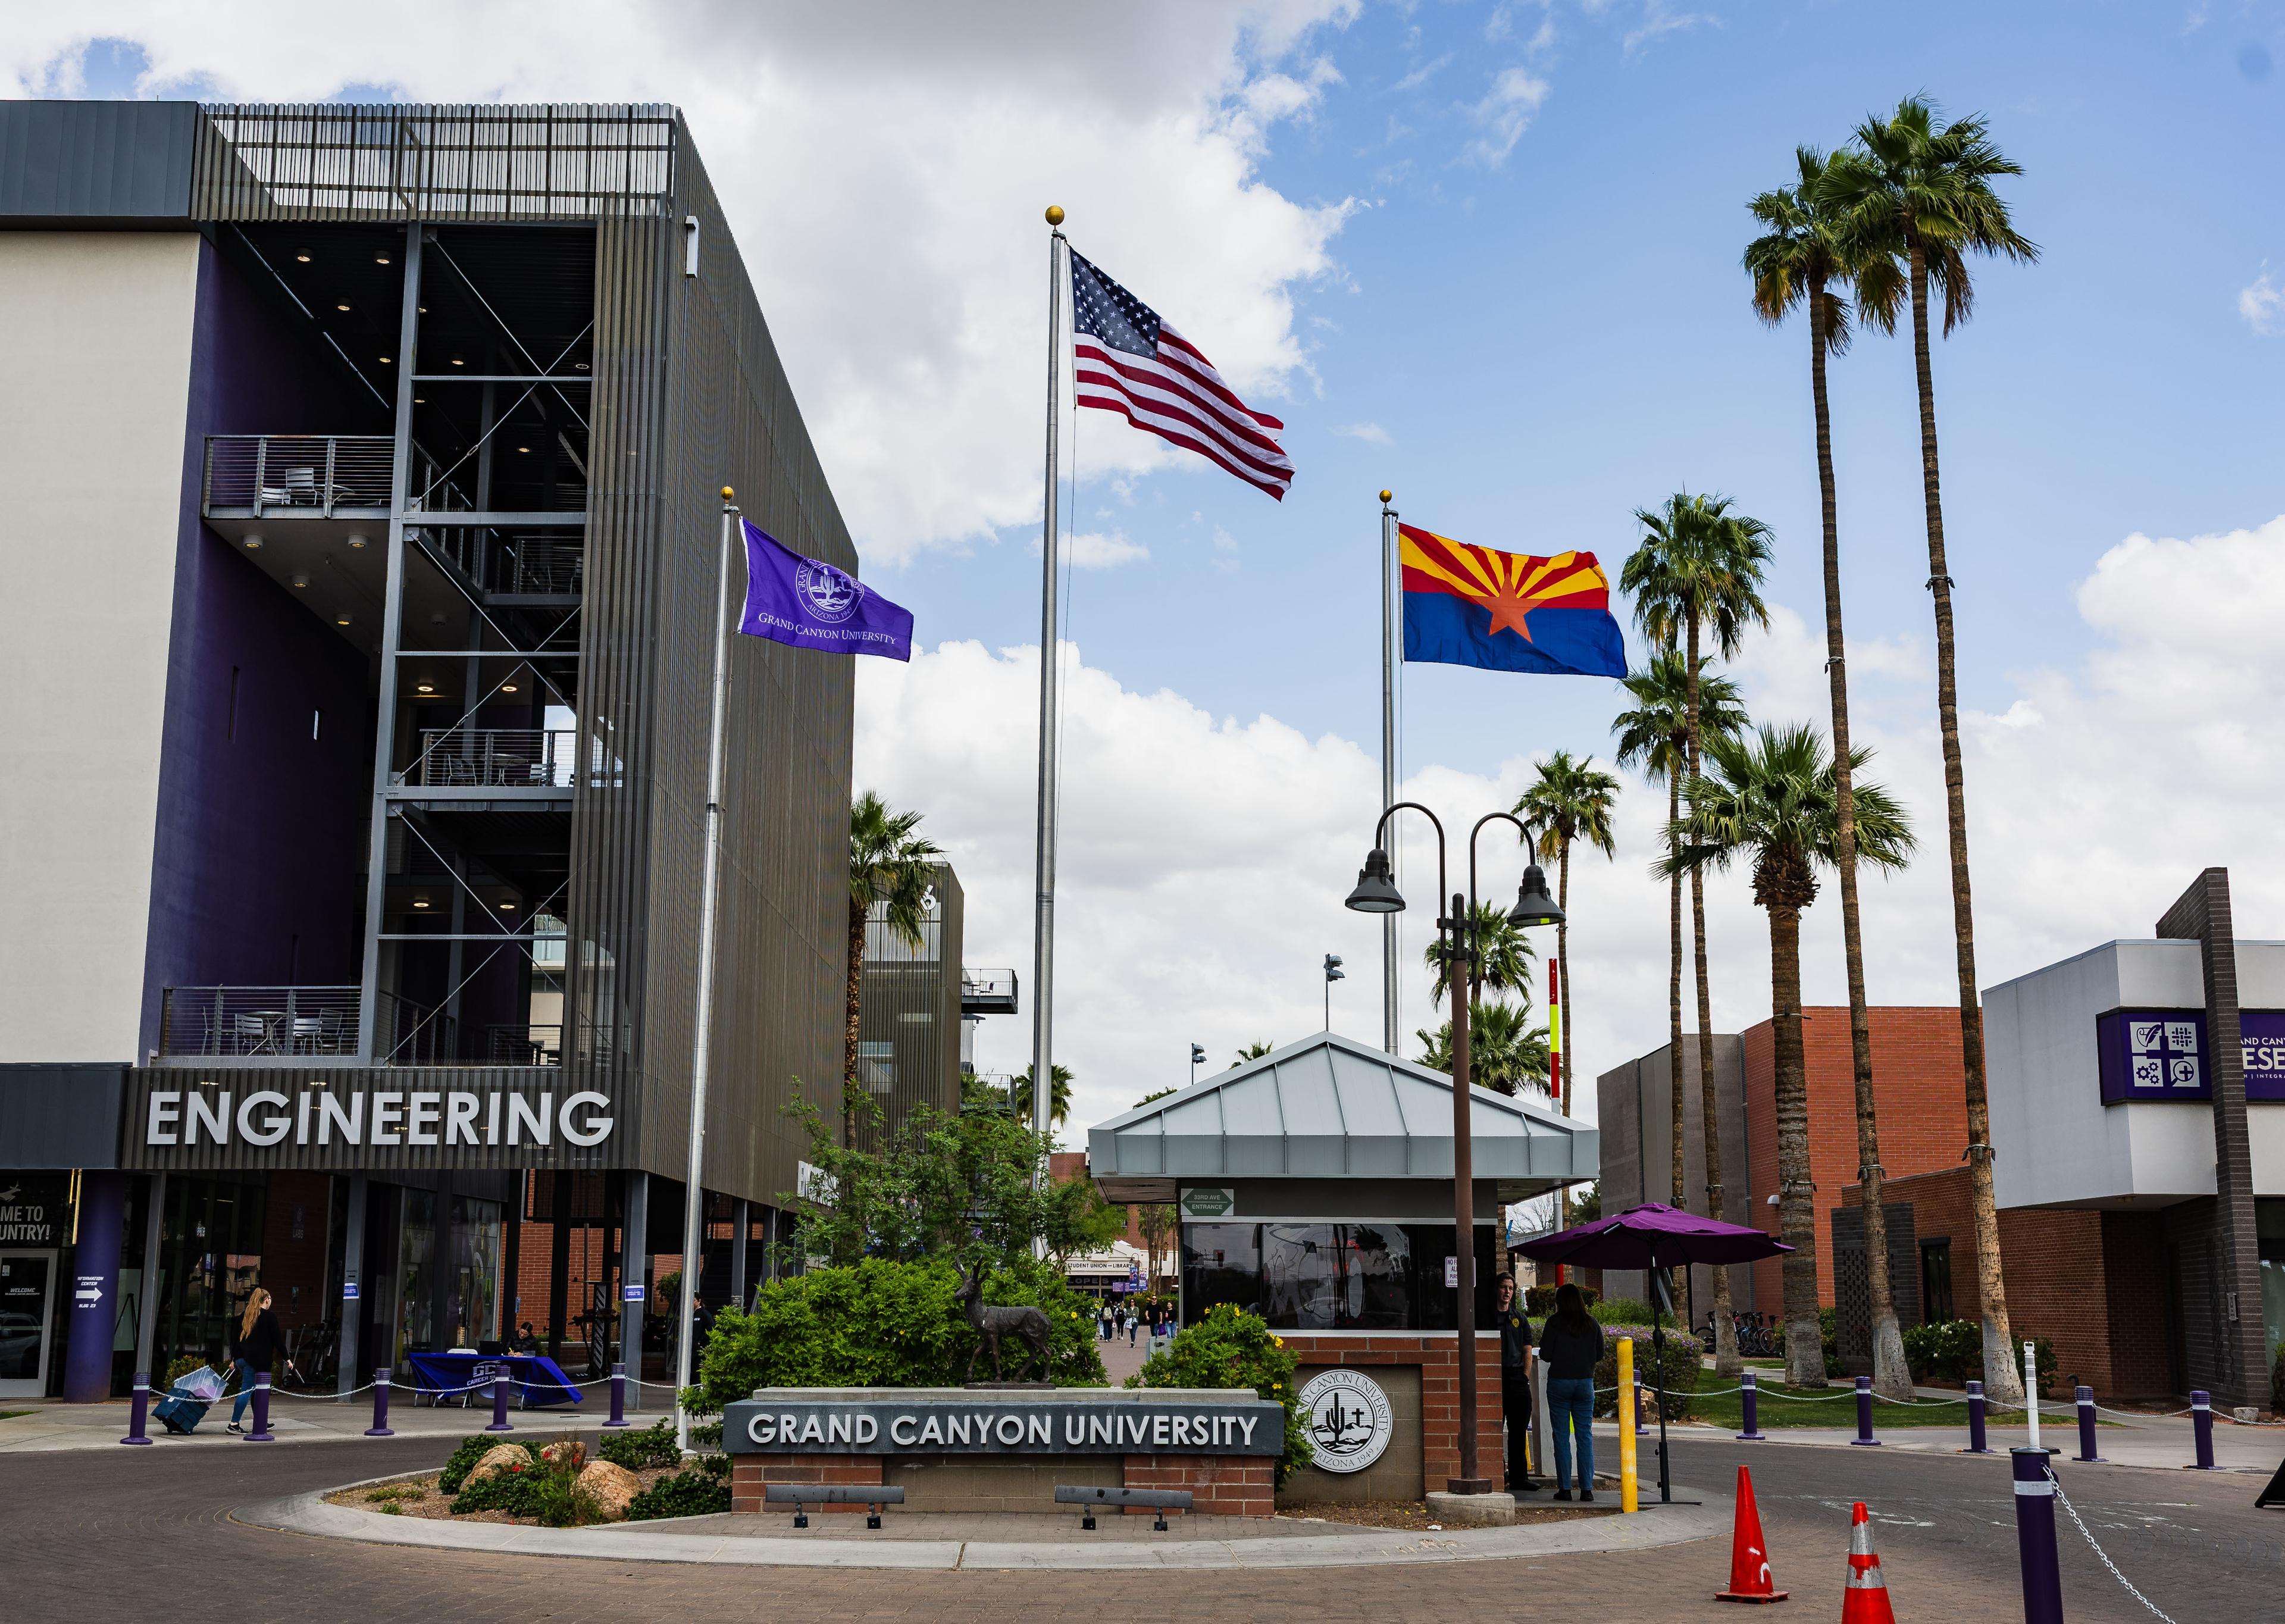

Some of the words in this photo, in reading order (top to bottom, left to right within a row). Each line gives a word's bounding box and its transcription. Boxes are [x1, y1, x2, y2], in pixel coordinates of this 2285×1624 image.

[807, 604, 839, 620] ARIZONA
[841, 606, 853, 619] 1949
[147, 1090, 613, 1146] ENGINEERING
[26, 1206, 43, 1221] TO
[473, 1365, 497, 1378] GC
[467, 1375, 489, 1386] CAREER
[1309, 1373, 1353, 1394] CANYON
[1355, 1376, 1388, 1434] UNIVERSITY
[747, 1413, 878, 1444] GRAND
[891, 1415, 1051, 1445] CANYON
[1066, 1415, 1259, 1445] UNIVERSITY
[1357, 1448, 1374, 1463] 1949
